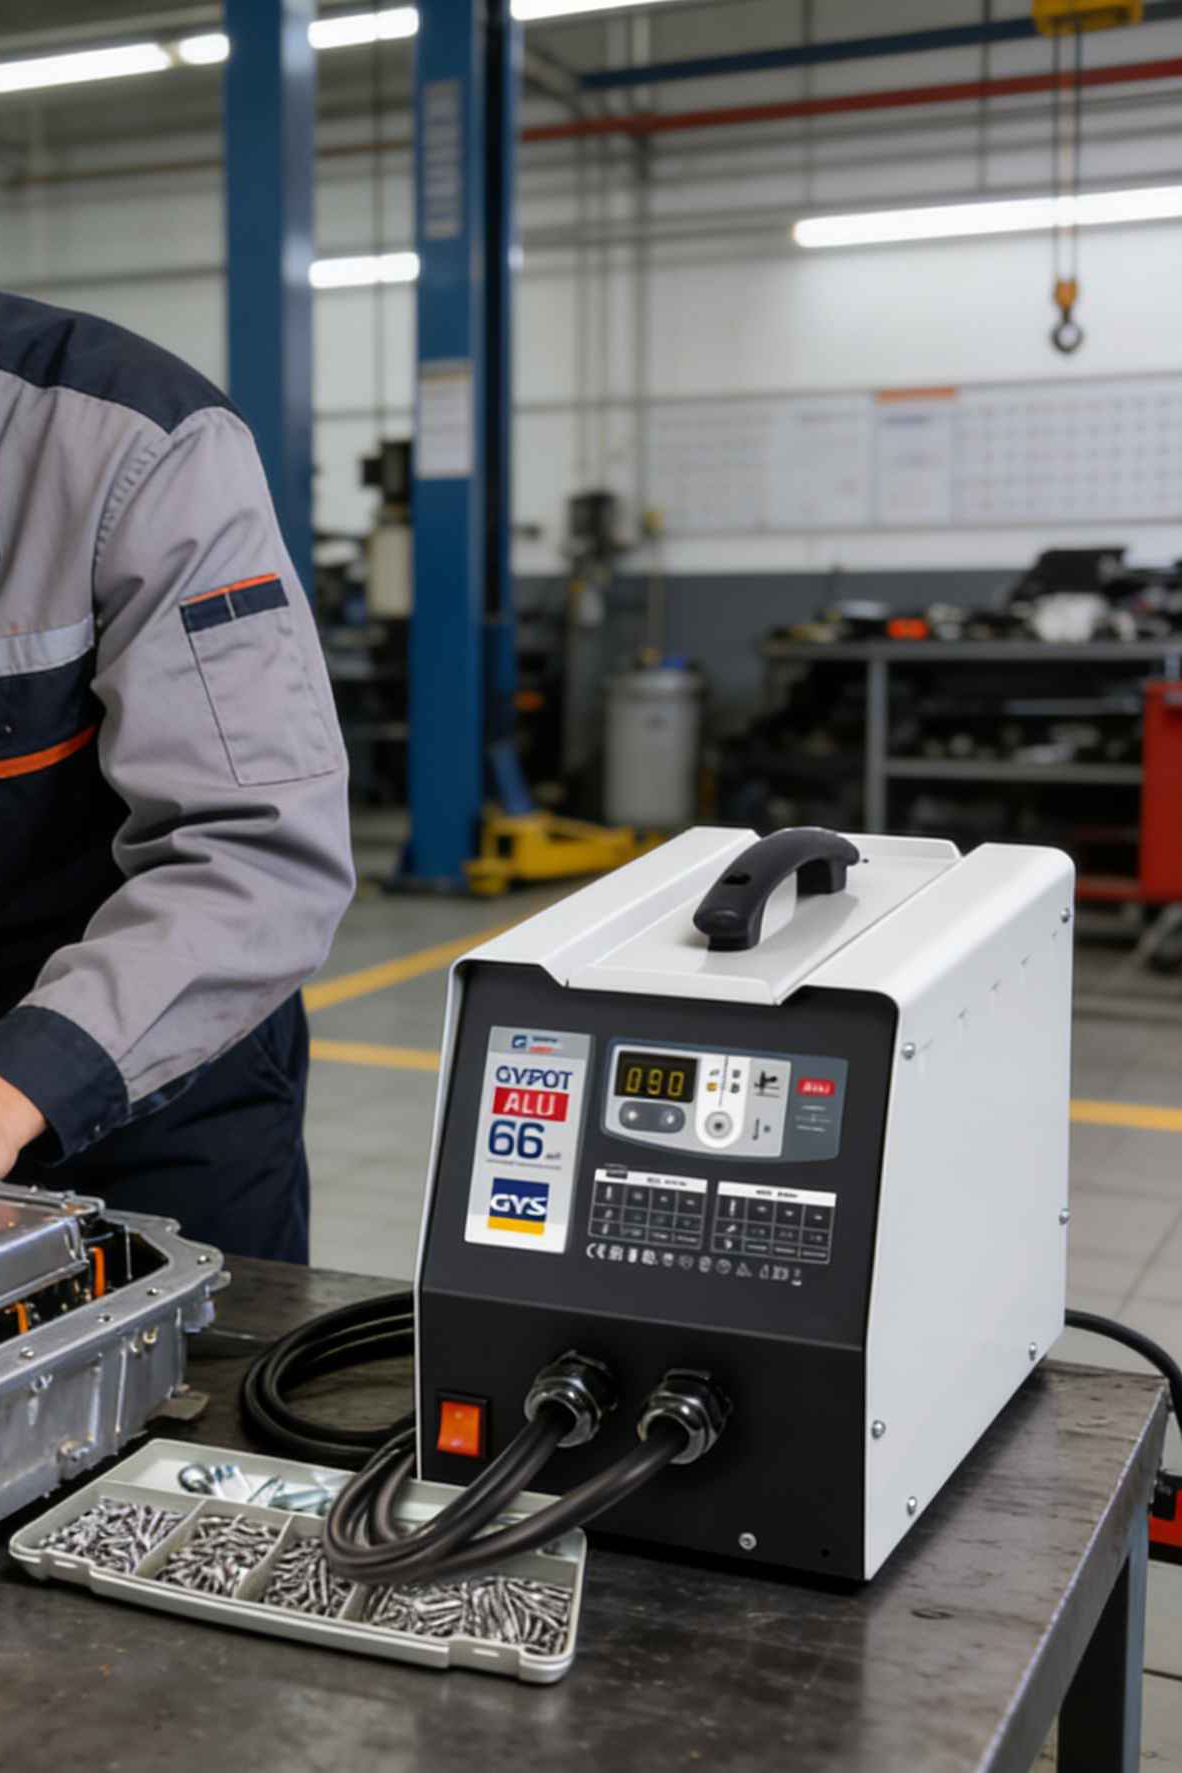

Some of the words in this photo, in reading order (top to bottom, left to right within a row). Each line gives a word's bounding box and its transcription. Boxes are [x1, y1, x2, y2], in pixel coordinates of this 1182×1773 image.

[625, 1067, 685, 1097] 090
[503, 1092, 555, 1117] ALU
[487, 1119, 545, 1160] 66
